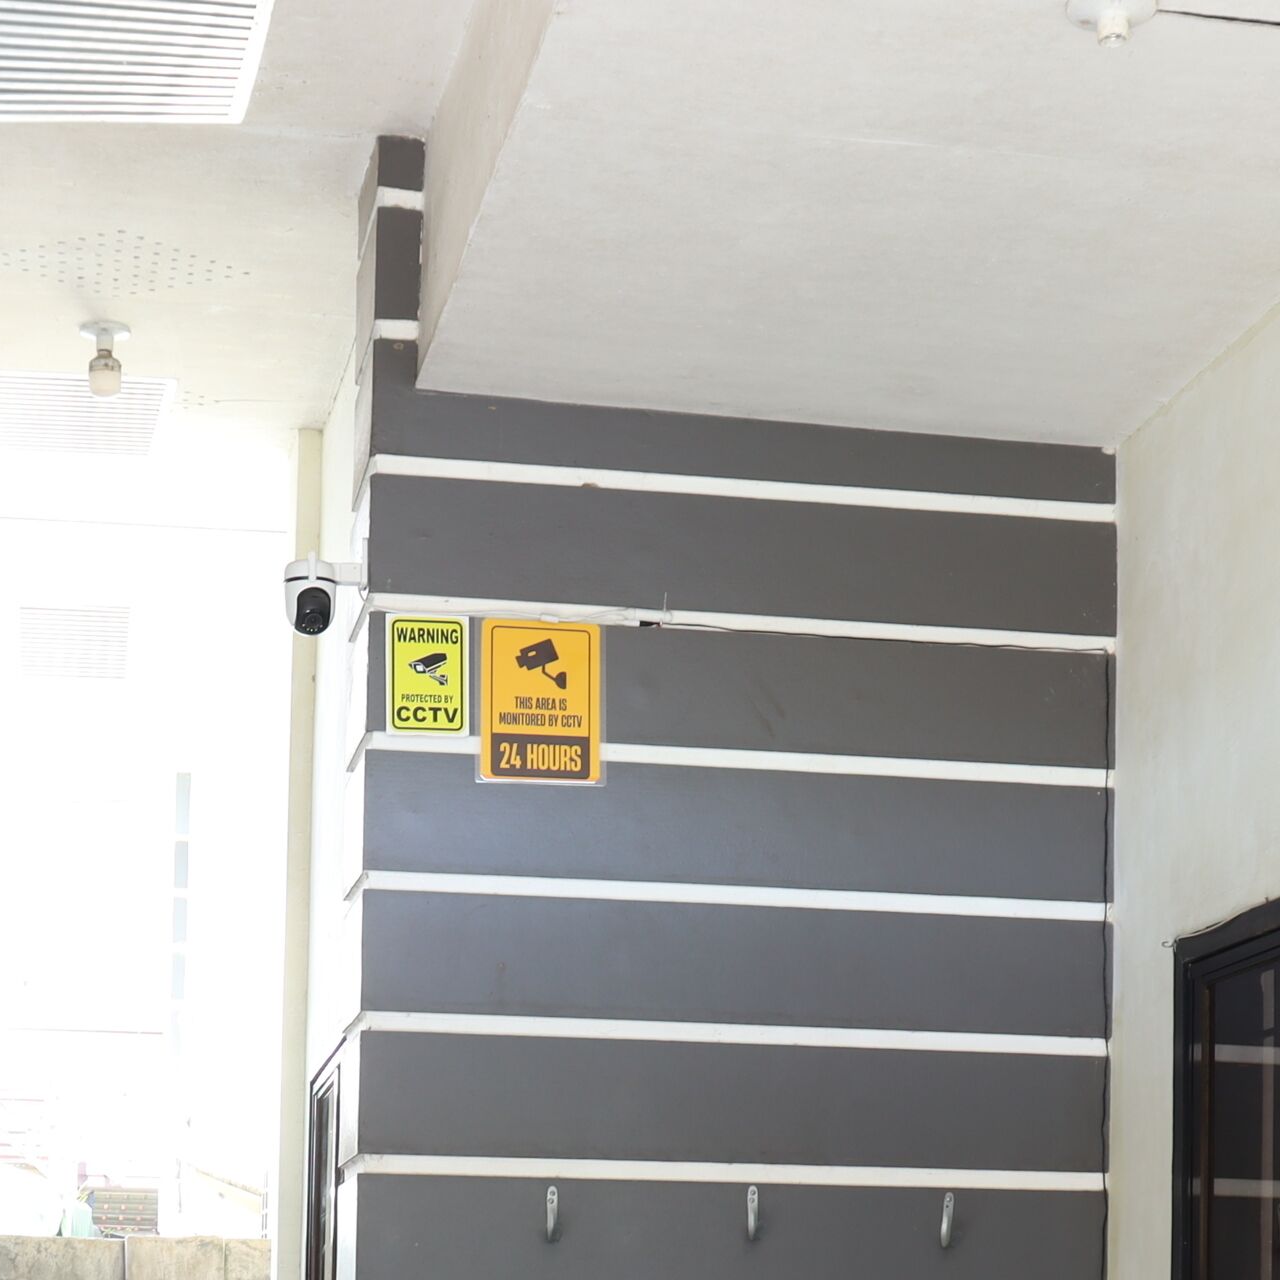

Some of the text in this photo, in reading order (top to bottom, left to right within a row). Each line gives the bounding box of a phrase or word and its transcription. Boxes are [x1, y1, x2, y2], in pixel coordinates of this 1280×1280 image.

[396, 627, 459, 645] WARNING
[401, 693, 453, 704] PROTECTED BY
[514, 696, 567, 711] THIS AREA IS
[396, 706, 459, 724] CCTV
[499, 712, 582, 728] MONITORED BY CCTV
[499, 742, 582, 771] 24 HOURS
